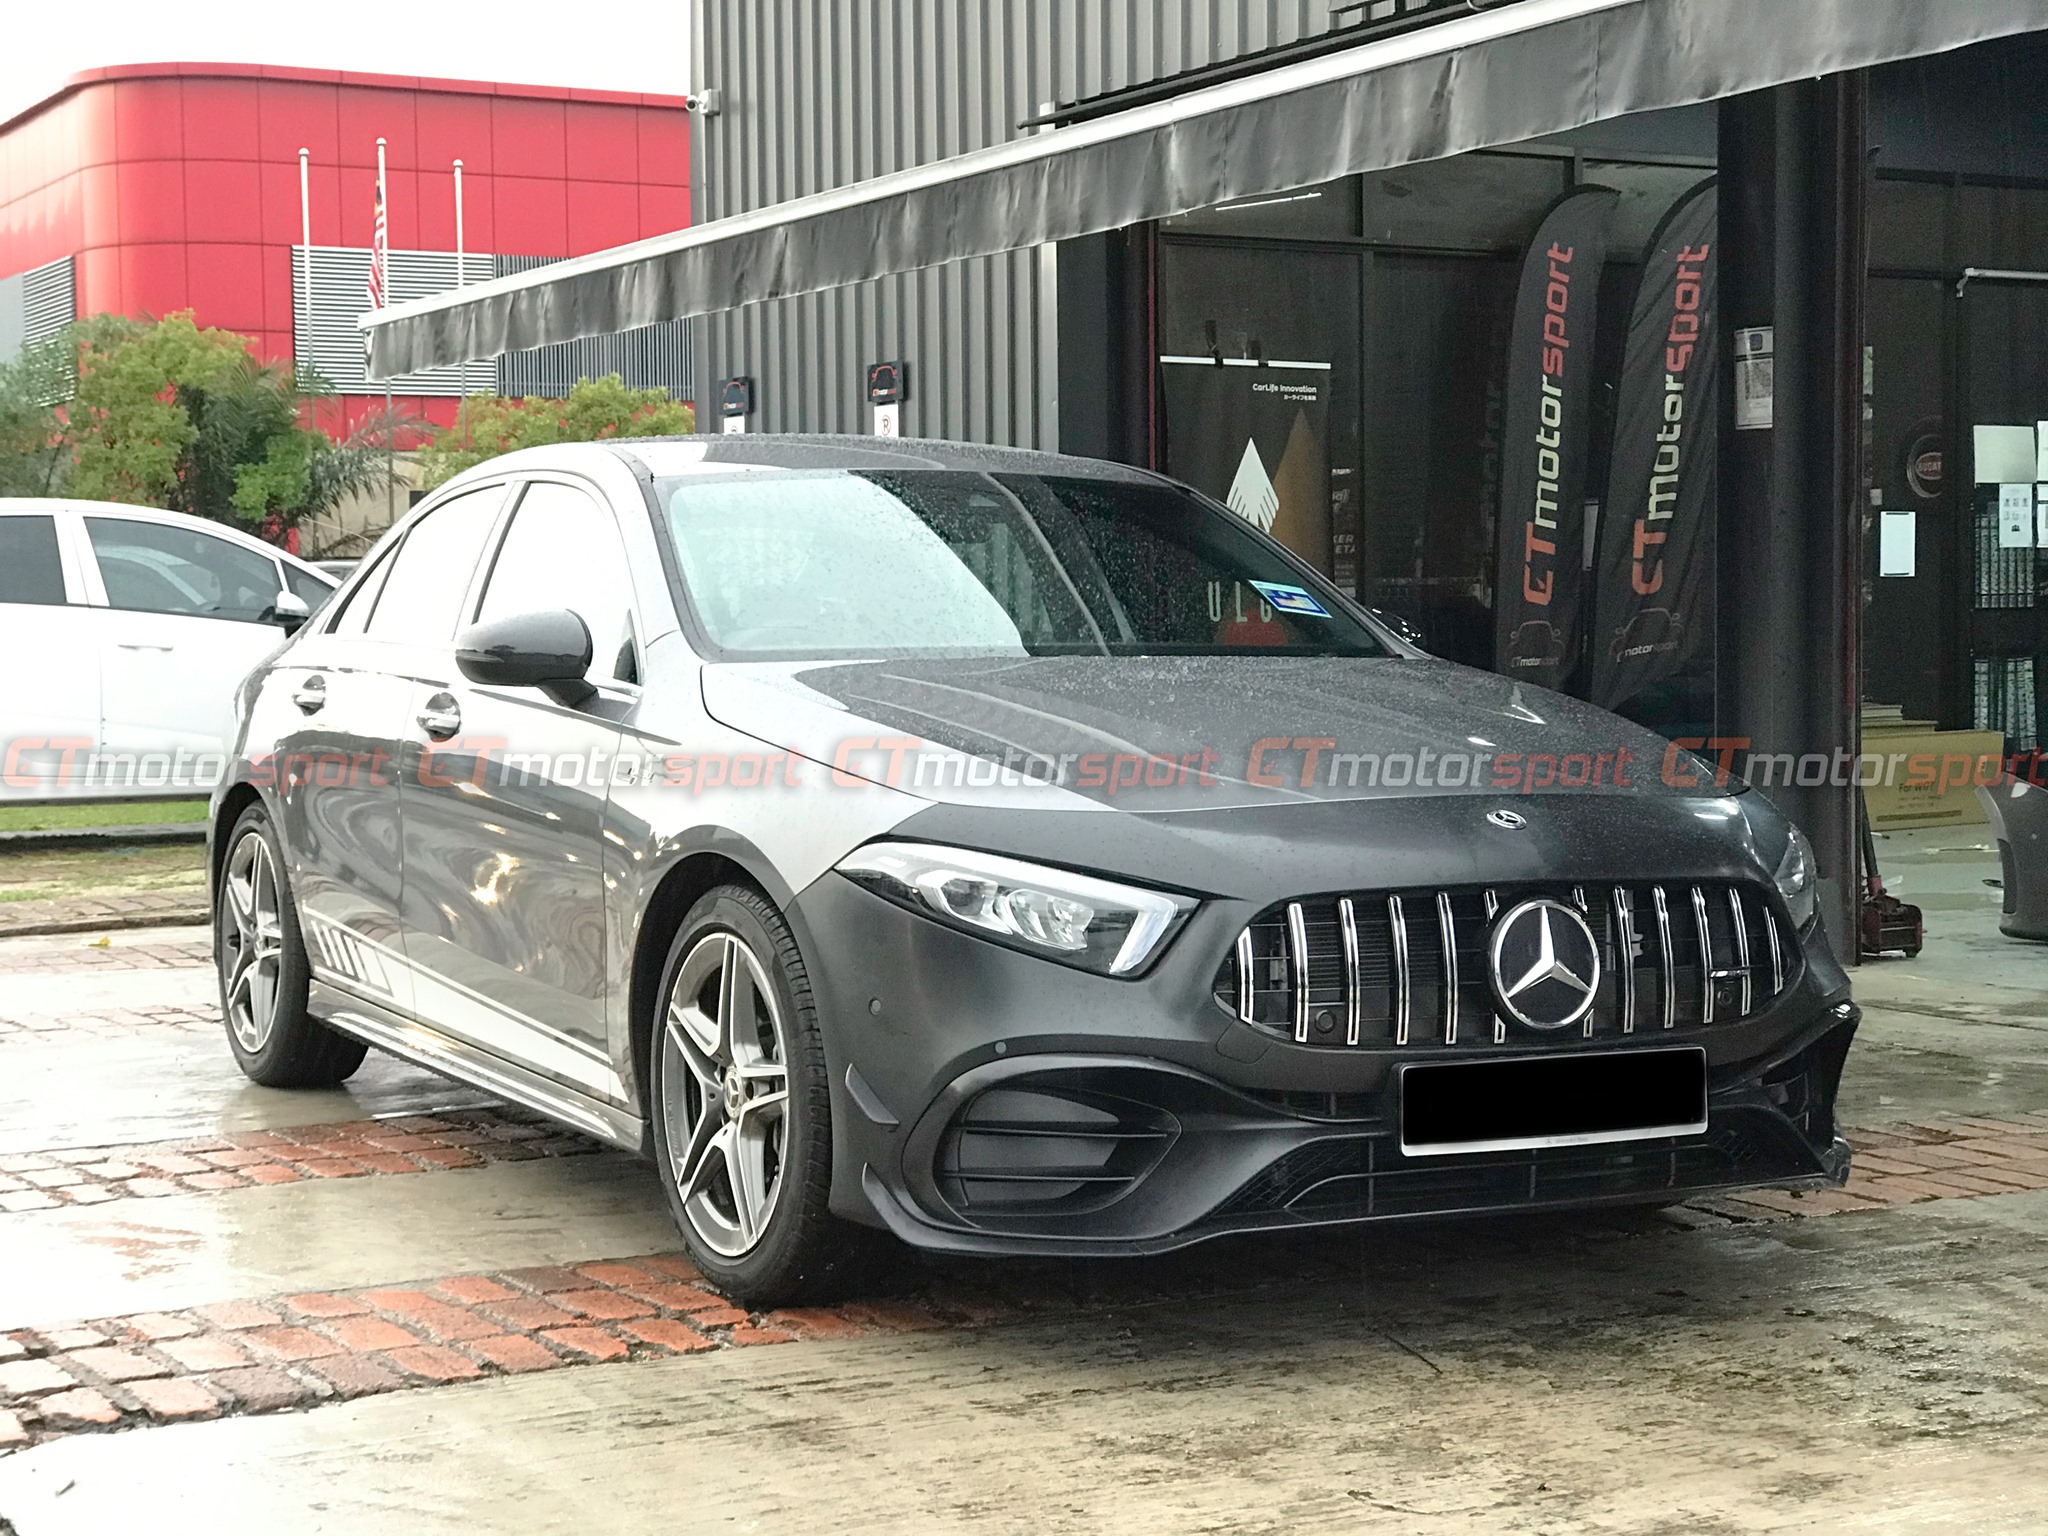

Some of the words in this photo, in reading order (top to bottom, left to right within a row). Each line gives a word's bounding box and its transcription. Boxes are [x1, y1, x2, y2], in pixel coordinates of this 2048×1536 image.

[1252, 383, 1279, 393] CarLife
[1280, 385, 1317, 393] Innovation
[1524, 241, 1573, 606] CTmotorsport
[1631, 243, 1709, 595] CTmotorsport
